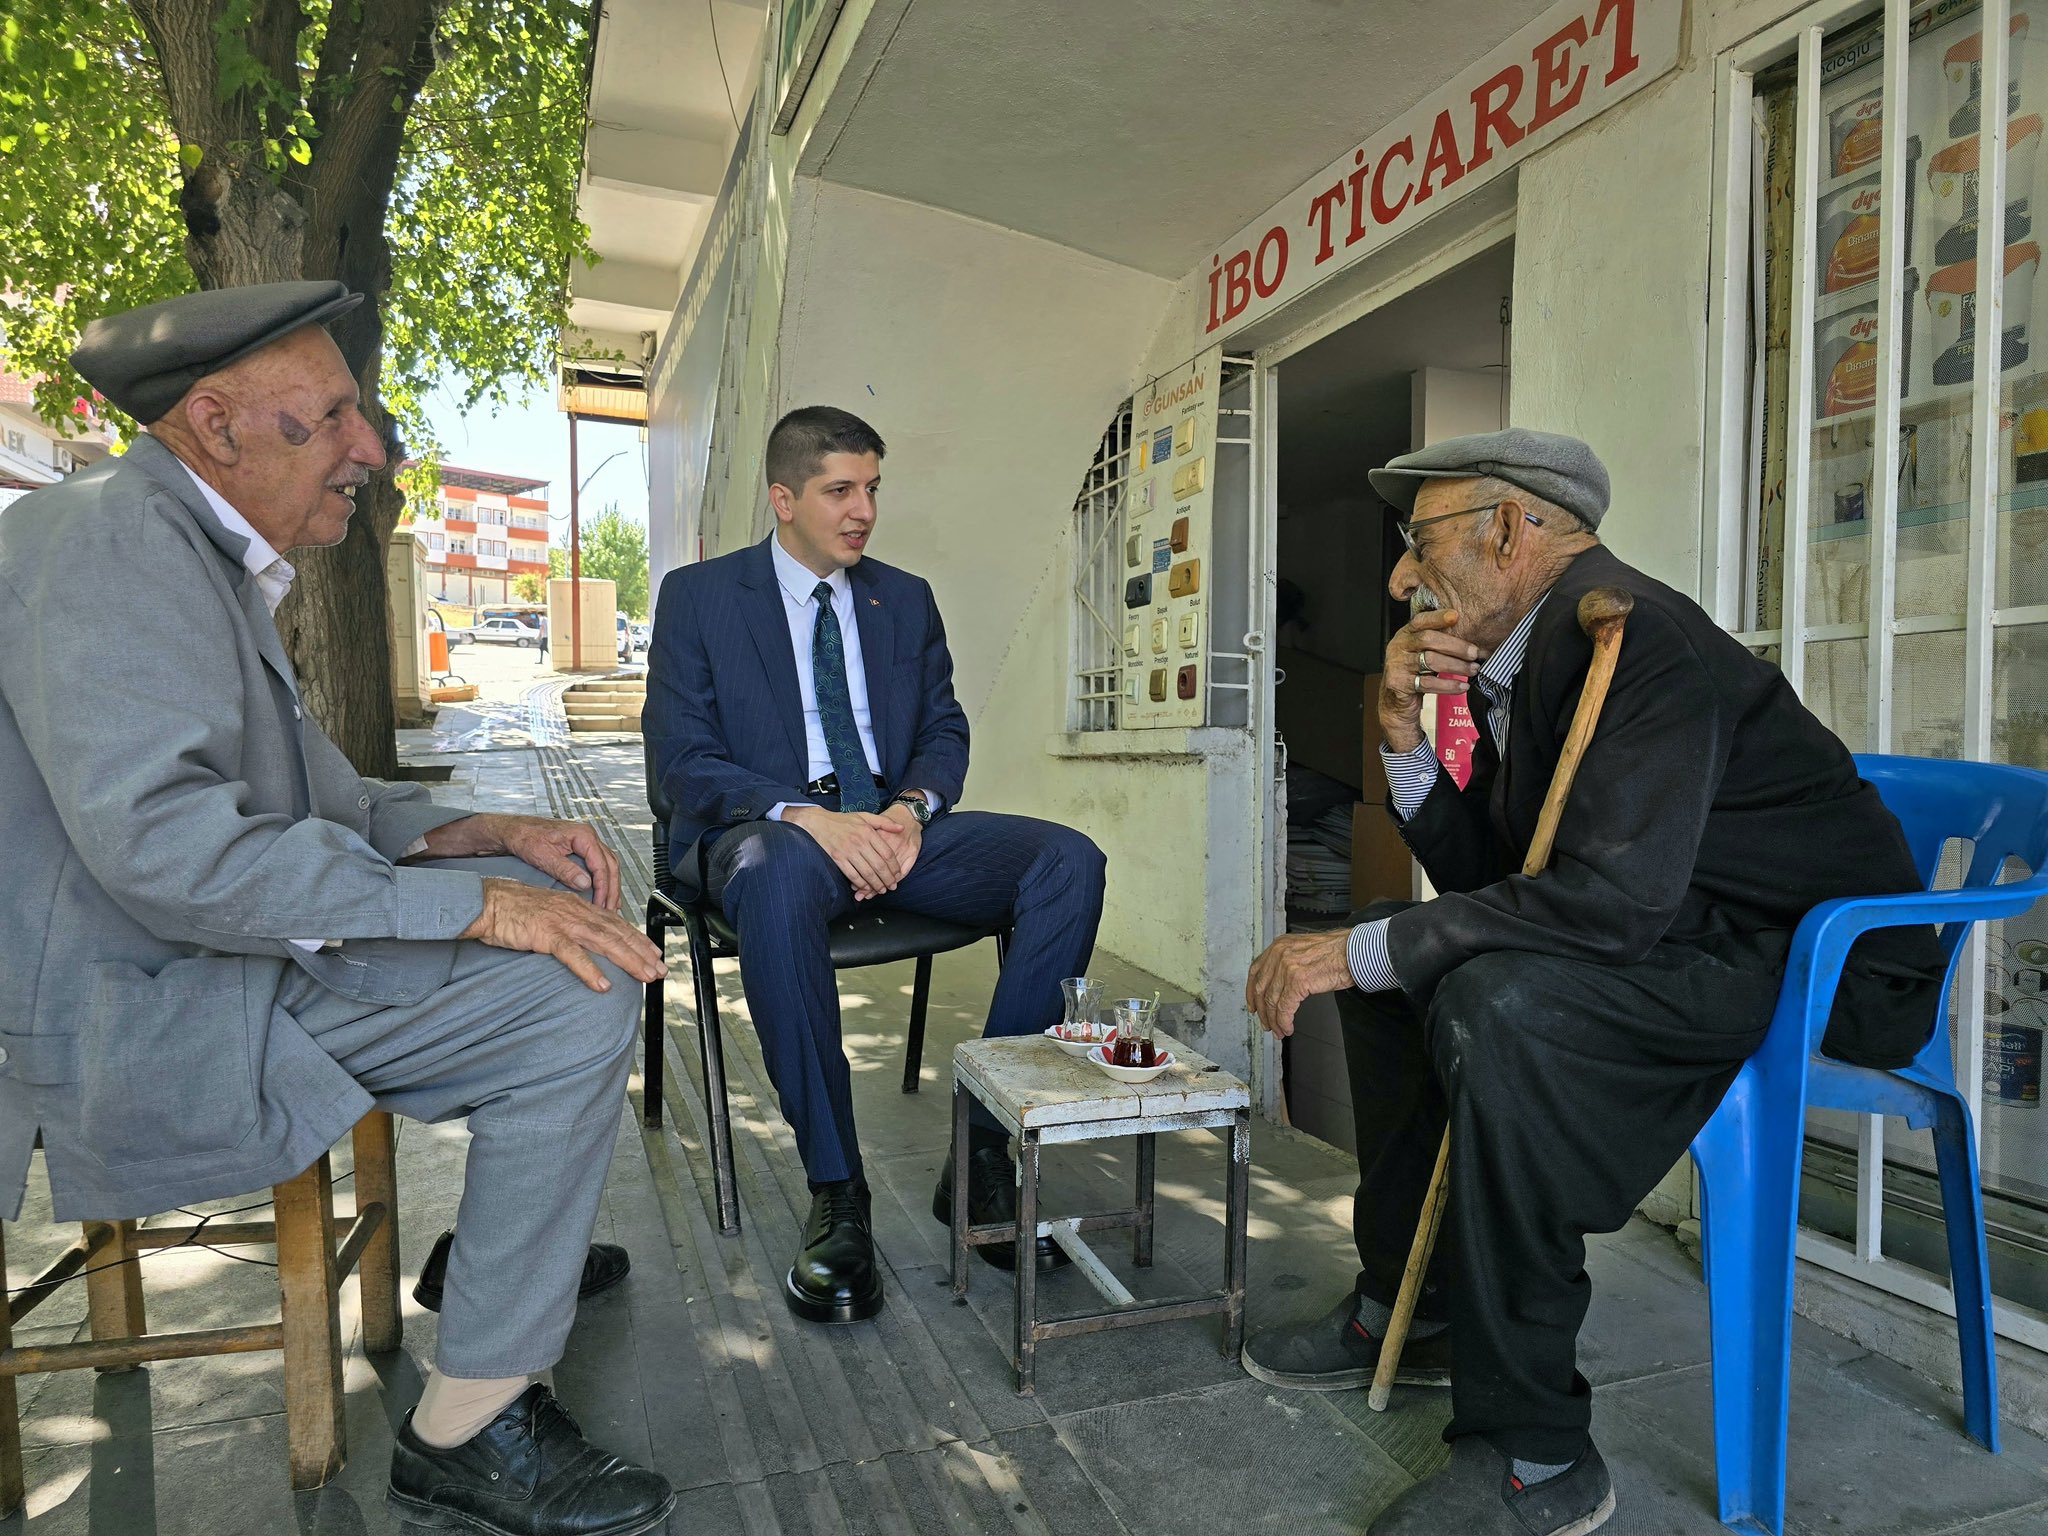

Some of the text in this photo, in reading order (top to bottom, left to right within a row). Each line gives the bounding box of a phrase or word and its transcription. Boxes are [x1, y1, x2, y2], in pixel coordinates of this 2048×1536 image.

[1206, 0, 1640, 335] İBO TİCARET
[1176, 505, 1191, 515] Antique
[1445, 748, 1456, 761] 50
